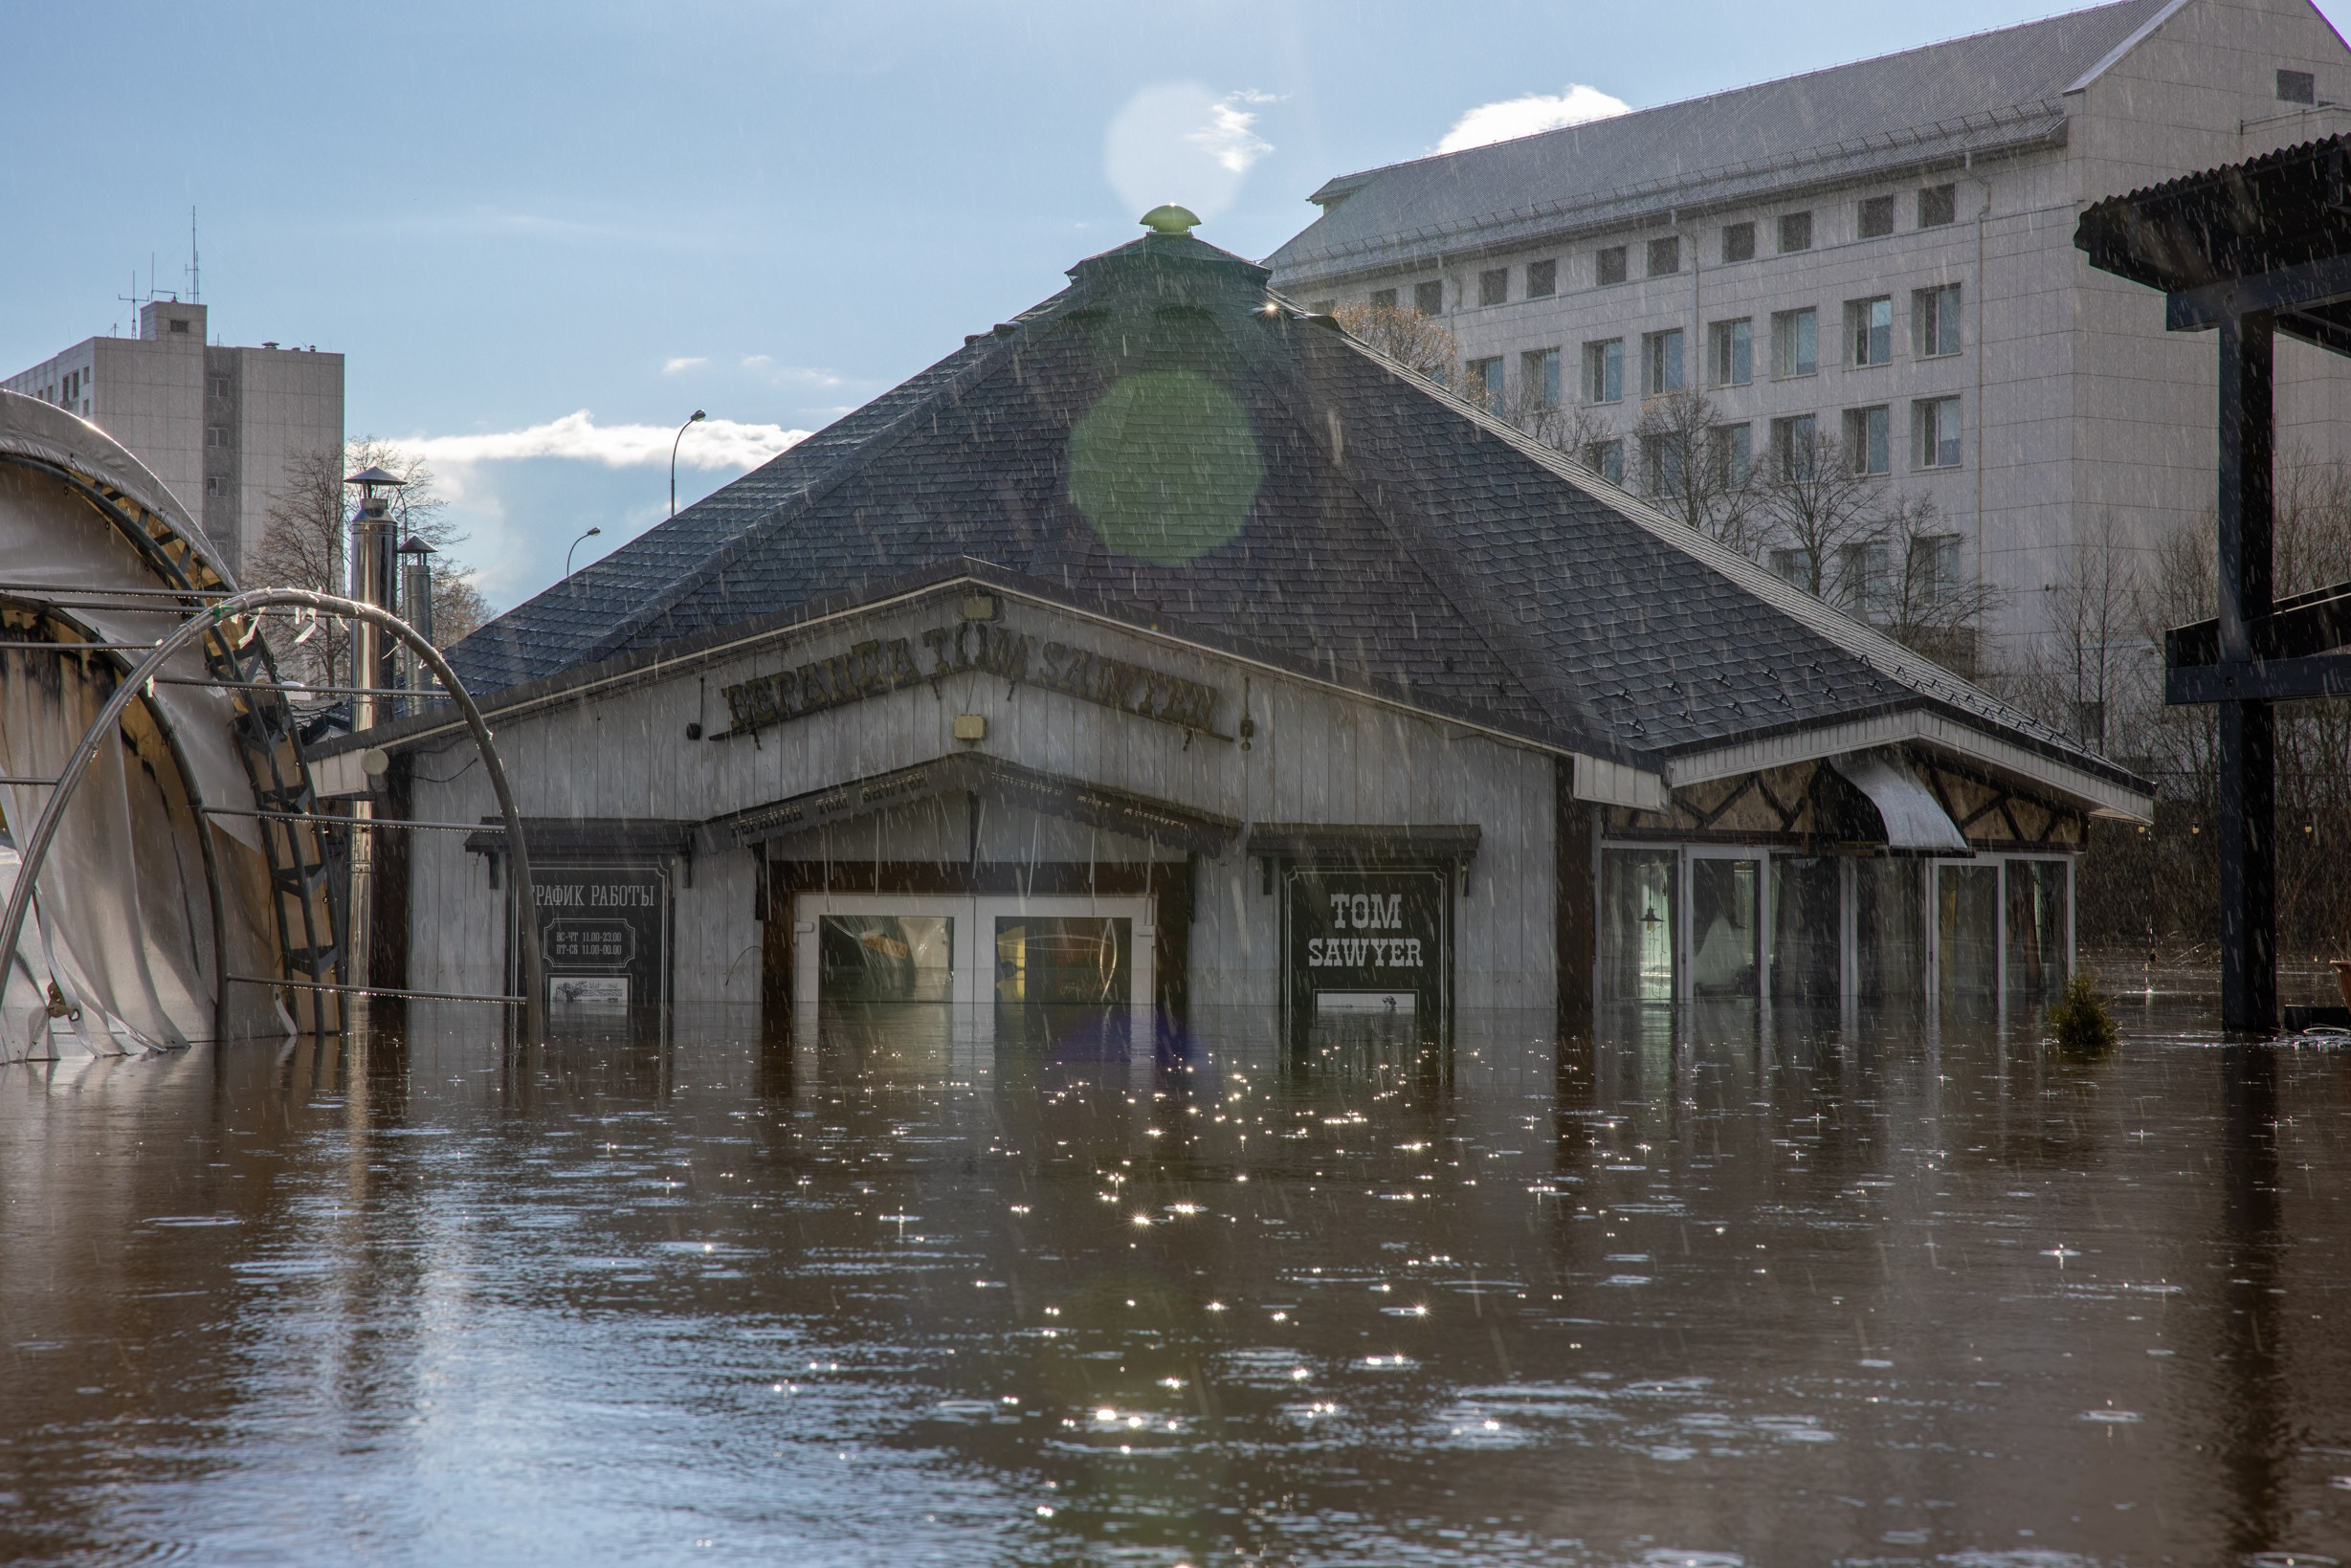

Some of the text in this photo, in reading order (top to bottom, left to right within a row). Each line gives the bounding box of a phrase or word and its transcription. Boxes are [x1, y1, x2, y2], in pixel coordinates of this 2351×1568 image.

[921, 622, 1034, 678] TOM
[1037, 641, 1218, 732] SAWYER
[590, 885, 654, 906] РАБОТЫ
[1330, 894, 1402, 929] TOM
[556, 932, 622, 942] ВС-ЧТ 11.00-23.00
[556, 944, 622, 955] ПТ-СБ 11.00-00.00
[1308, 938, 1424, 967] SAWYER
